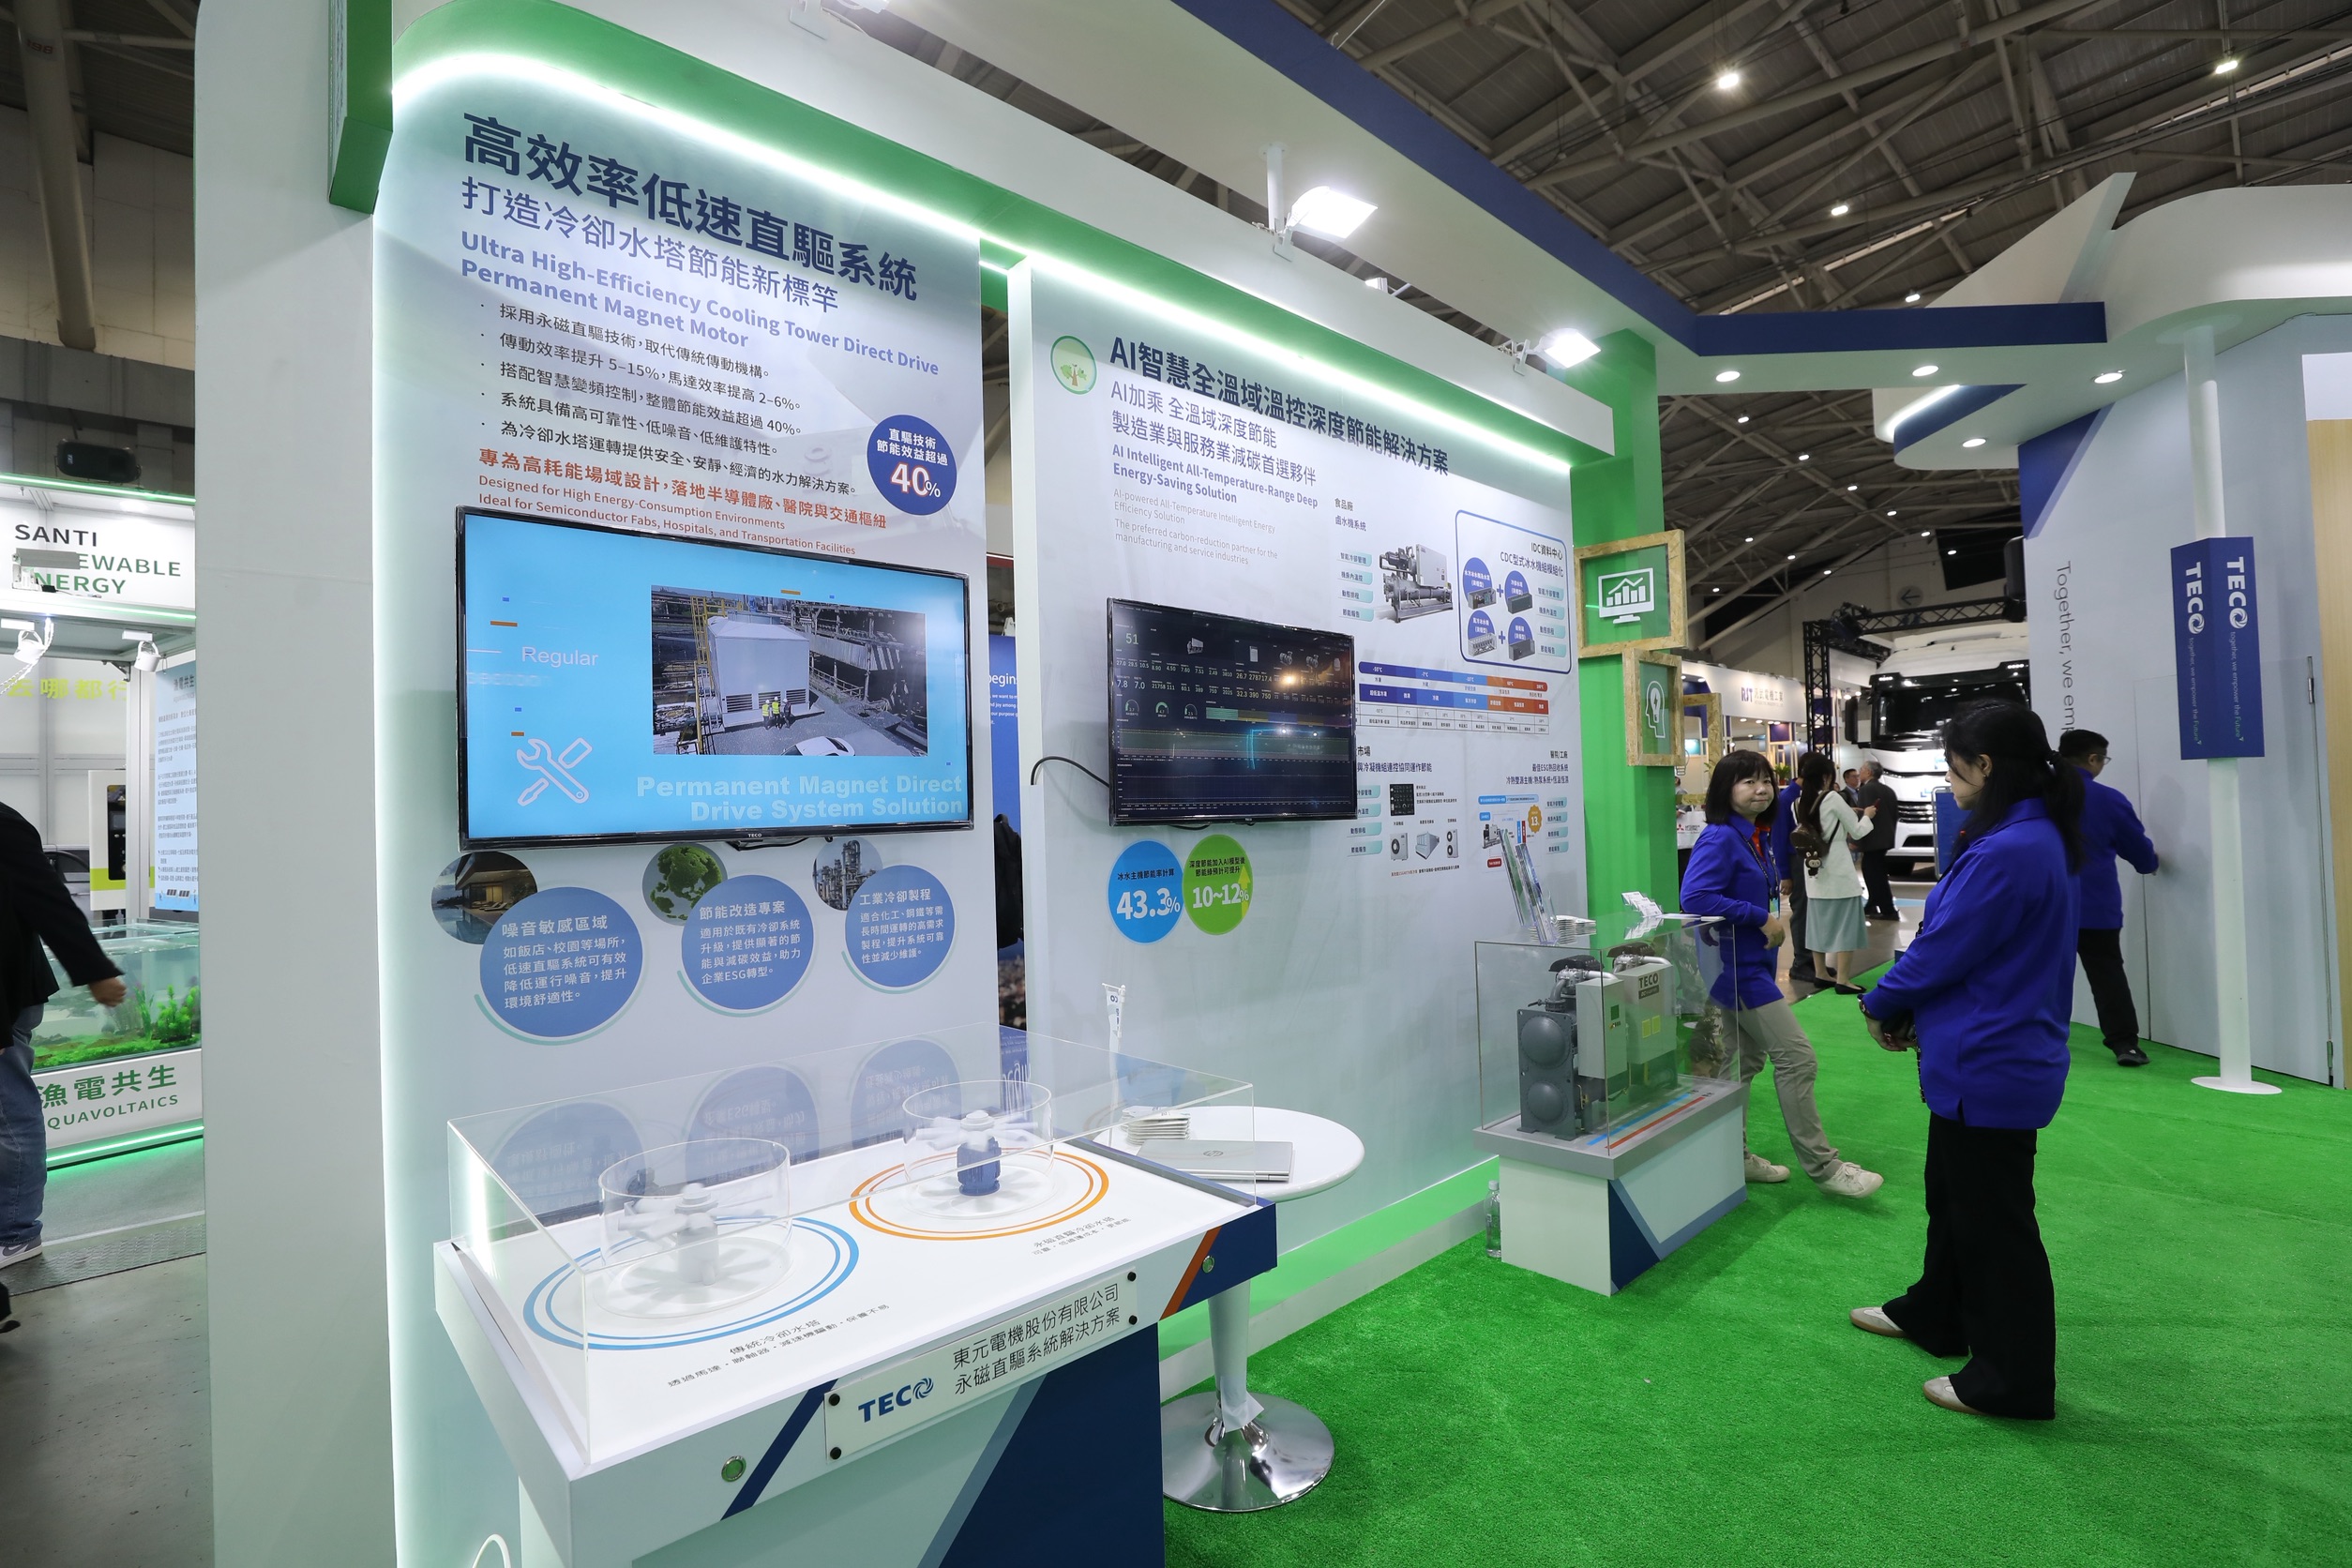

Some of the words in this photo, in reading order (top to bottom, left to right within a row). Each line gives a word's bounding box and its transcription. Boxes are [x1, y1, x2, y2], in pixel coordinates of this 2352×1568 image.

[463, 113, 917, 301] 高效率低速直驅系統
[461, 176, 838, 313] 打造冷卻水塔節能新標竿
[461, 230, 524, 265] Ultra
[532, 249, 701, 314] High-Efficiency
[707, 299, 781, 338] Cooling
[785, 320, 839, 350] Tower
[844, 336, 894, 364] Direct
[897, 349, 939, 376] Drive
[461, 259, 597, 310] Permanent
[604, 293, 685, 334] Magnet
[690, 318, 748, 348] Motor
[499, 333, 604, 369] 傳動效率提升
[1109, 337, 1449, 476] AI智慧全溫域溫控深度節能解決方案
[1110, 380, 1164, 415] AI加乘
[1168, 391, 1277, 449] 全溫域深度節能
[877, 439, 948, 466] 節能效益超過
[888, 428, 936, 450] 直驅技術
[1111, 409, 1317, 487] 製造業與服務業減碳首選夥伴
[890, 461, 941, 498] 40%
[1112, 444, 1123, 458] AI
[1126, 447, 1184, 474] Intelligent
[1185, 464, 1295, 503] All-Temperature-Range
[1296, 492, 1318, 509] Deep
[1113, 462, 1193, 496] Energy-Saving
[1195, 485, 1237, 504] Solution
[479, 475, 538, 493] Designed
[542, 482, 561, 495] for
[564, 487, 591, 504] High
[594, 492, 712, 520] Energy-Consumption
[716, 511, 785, 530] Environments
[1114, 502, 1153, 520] Efficiency
[1154, 510, 1185, 524] Solution
[1160, 499, 1217, 521] All-Temperature
[1219, 511, 1253, 528] Intelligent
[1253, 519, 1275, 535] Energy
[1334, 498, 1353, 511] 食品廠
[14, 524, 98, 547] SANTI
[479, 493, 511, 508] Ideal
[515, 497, 533, 510] for
[536, 502, 628, 523] Semiconductor
[631, 515, 660, 529] Fabs,
[663, 520, 716, 537] Hospitals,
[719, 528, 739, 538] and
[741, 531, 813, 550] Transportation
[816, 541, 855, 555] Facilities
[1115, 518, 1130, 531] The
[1131, 521, 1168, 537] preferred
[1168, 529, 1230, 550] carbon-reduction
[1231, 542, 1256, 556] partner
[1257, 546, 1266, 556] for
[1267, 548, 1278, 559] the
[79, 552, 181, 577] EWABLE
[1115, 532, 1172, 553] manufacturing
[1174, 541, 1187, 553] and
[1189, 545, 1214, 558] service
[1215, 549, 1249, 565] industries
[1530, 542, 1563, 560] IDC資料中心
[30, 568, 126, 595] NERGY
[2185, 561, 2205, 634] TECO
[2226, 556, 2248, 629] TECO
[2054, 561, 2075, 655] Together,
[1125, 633, 1138, 645] 51
[521, 645, 598, 667] Regular
[1117, 679, 1128, 688] 7.8
[1134, 681, 1145, 689] 7.0
[2062, 659, 2074, 688] we
[1357, 746, 1371, 756] 市場
[637, 776, 791, 798] Permanent
[798, 775, 889, 798] Magnet
[897, 774, 961, 793] Direct
[690, 800, 763, 822] Drive
[771, 799, 865, 822] System
[871, 795, 963, 817] Solution
[700, 900, 786, 920] 節能改造專案
[860, 888, 931, 905] 工業冷卻製程
[1116, 887, 1181, 920] 43.3%
[1192, 882, 1249, 909] 10~12%
[502, 914, 608, 938] 噪音敏感區域
[700, 919, 801, 939] 適用於既有冷卻系統
[861, 919, 943, 937] 長時間運轉的高需求
[504, 952, 626, 976] 低速直驅系統可有效
[701, 968, 773, 985] 企業ESG轉型。
[1638, 972, 1659, 988] TECO
[37, 1064, 177, 1108] 漁電共生
[48, 1094, 178, 1130] QUAVOLTAICS
[729, 1319, 822, 1355] 傳統冷卻水塔
[953, 1282, 1120, 1372] 東元電機股份有限公司
[955, 1307, 1121, 1396] 永磁直驅系統解決方案
[857, 1377, 935, 1424] TECO
